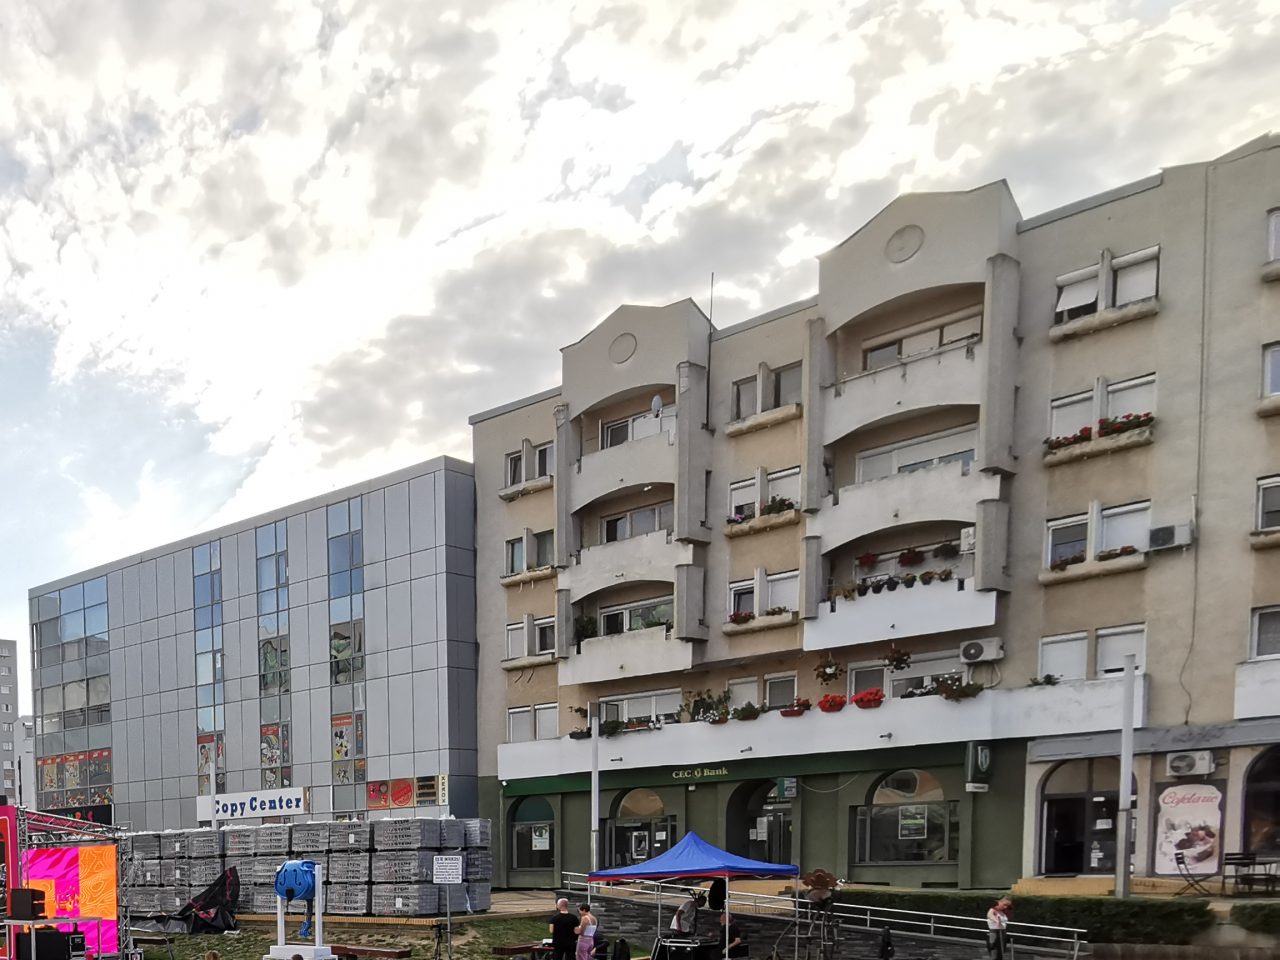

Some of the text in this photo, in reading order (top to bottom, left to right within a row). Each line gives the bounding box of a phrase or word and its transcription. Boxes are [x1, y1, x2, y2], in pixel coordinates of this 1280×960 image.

[672, 767, 728, 779] CEC Bank
[249, 795, 302, 812] Center
